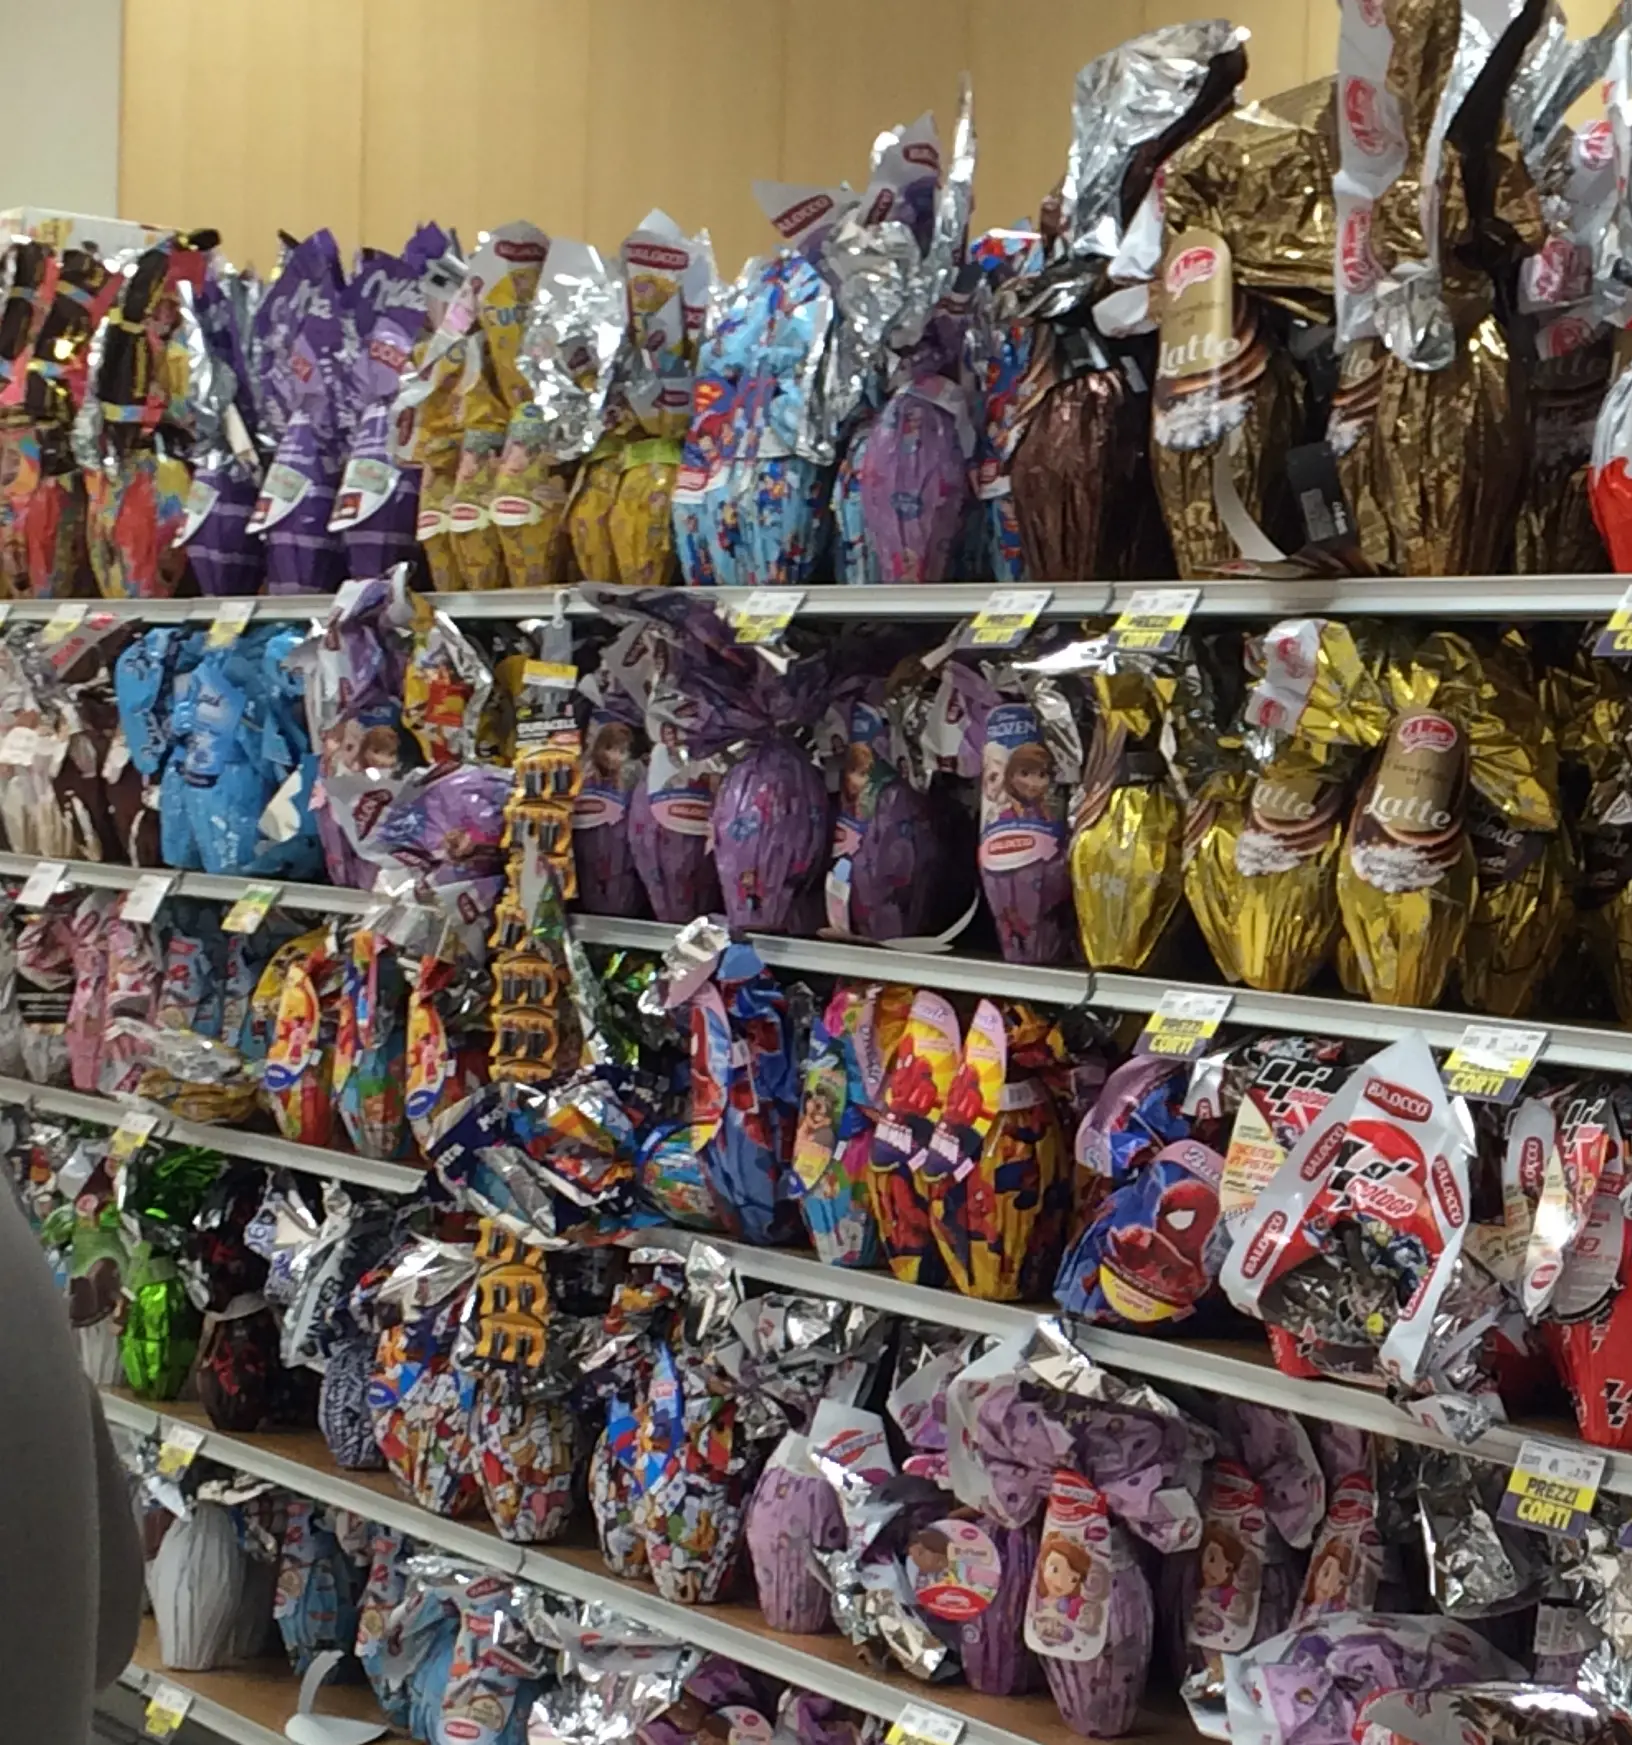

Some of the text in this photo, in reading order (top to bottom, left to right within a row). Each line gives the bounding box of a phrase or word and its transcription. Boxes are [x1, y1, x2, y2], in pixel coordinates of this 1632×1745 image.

[1363, 783, 1451, 831] Latte
[1366, 1081, 1430, 1118] BALOCCO
[1447, 1072, 1506, 1097] CORTI
[1303, 1123, 1347, 1181] BALOCCO
[1436, 1157, 1463, 1225] BALOCCO
[1244, 1212, 1284, 1274] BALOCCO
[1527, 1477, 1580, 1503] PREZZI
[1516, 1500, 1572, 1531] CORTI
